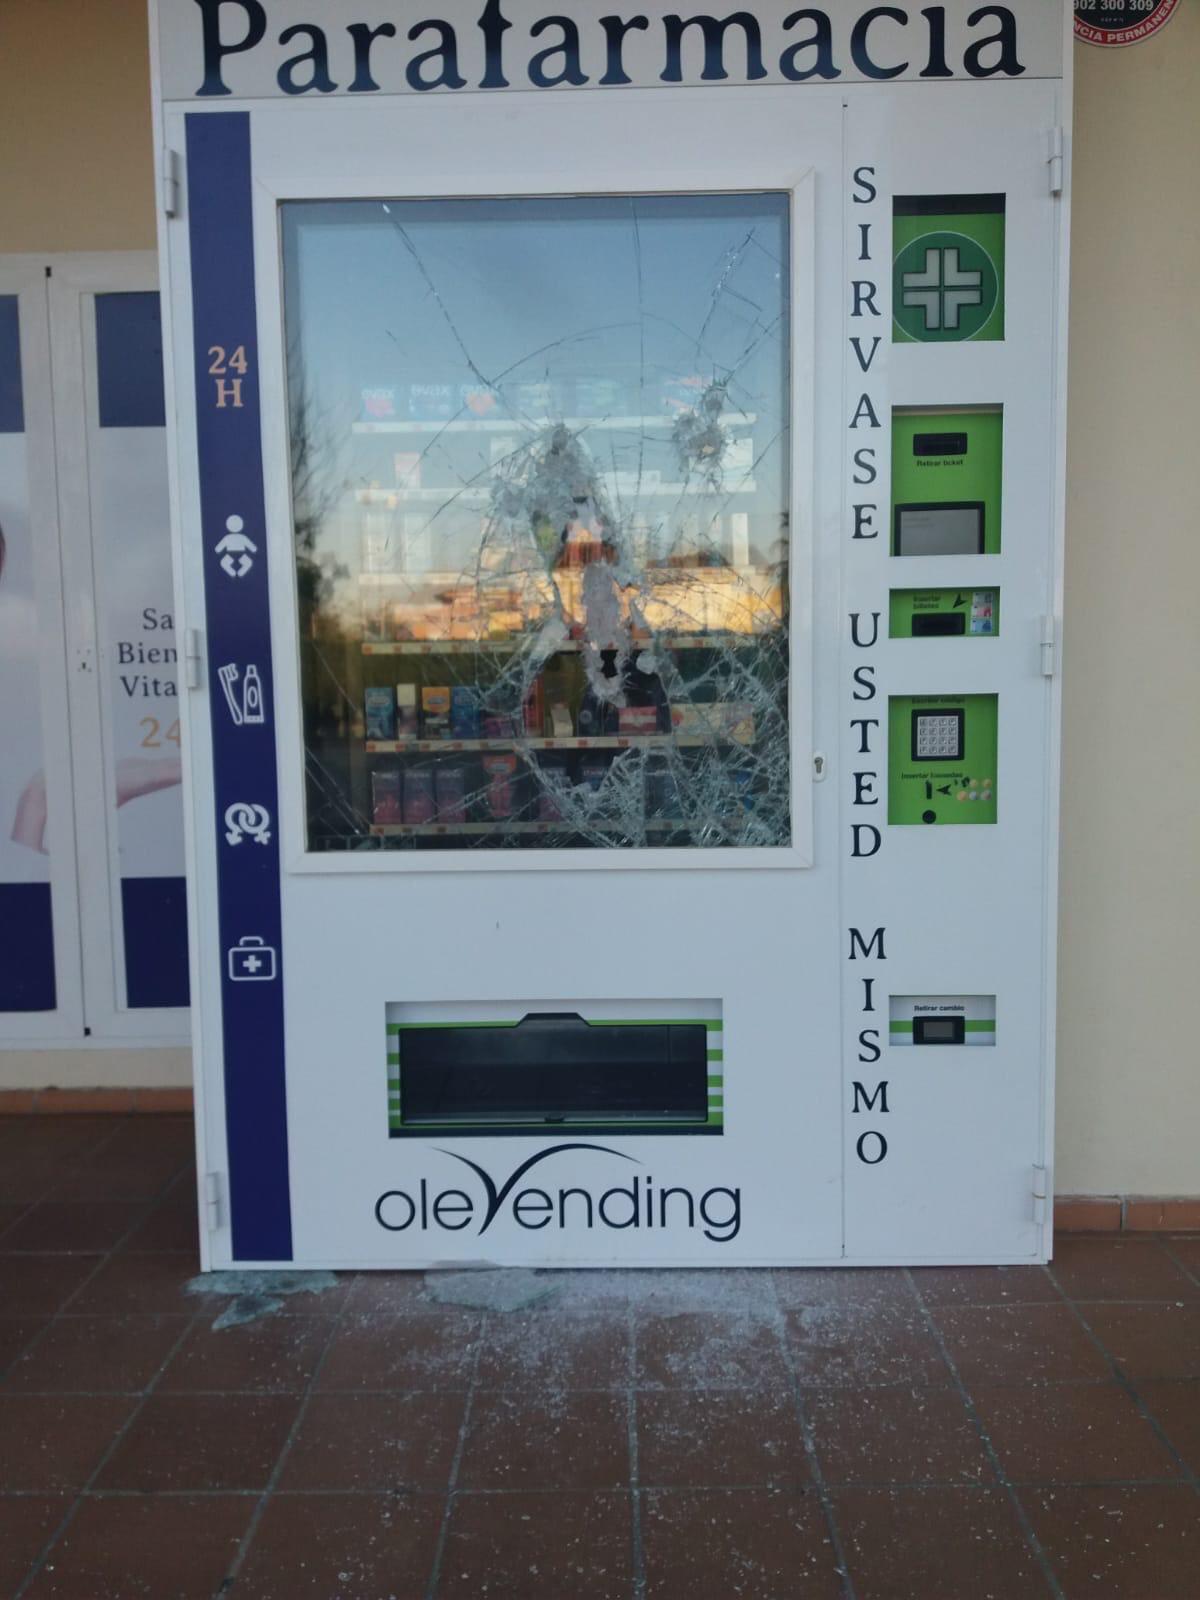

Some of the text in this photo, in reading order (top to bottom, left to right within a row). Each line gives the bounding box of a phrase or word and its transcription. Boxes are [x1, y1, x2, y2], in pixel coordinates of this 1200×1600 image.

[1100, 0, 1125, 10] 300
[1129, 0, 1154, 11] 309
[195, 0, 1027, 97] Parafarmacia
[207, 345, 248, 374] 24
[215, 378, 245, 408] H
[142, 607, 174, 630] Sa
[118, 642, 178, 665] Bien
[847, 166, 890, 1165] SIRVASE USTED MISMO
[120, 675, 178, 698] Vita
[914, 1004, 965, 1012] Retirar cambio
